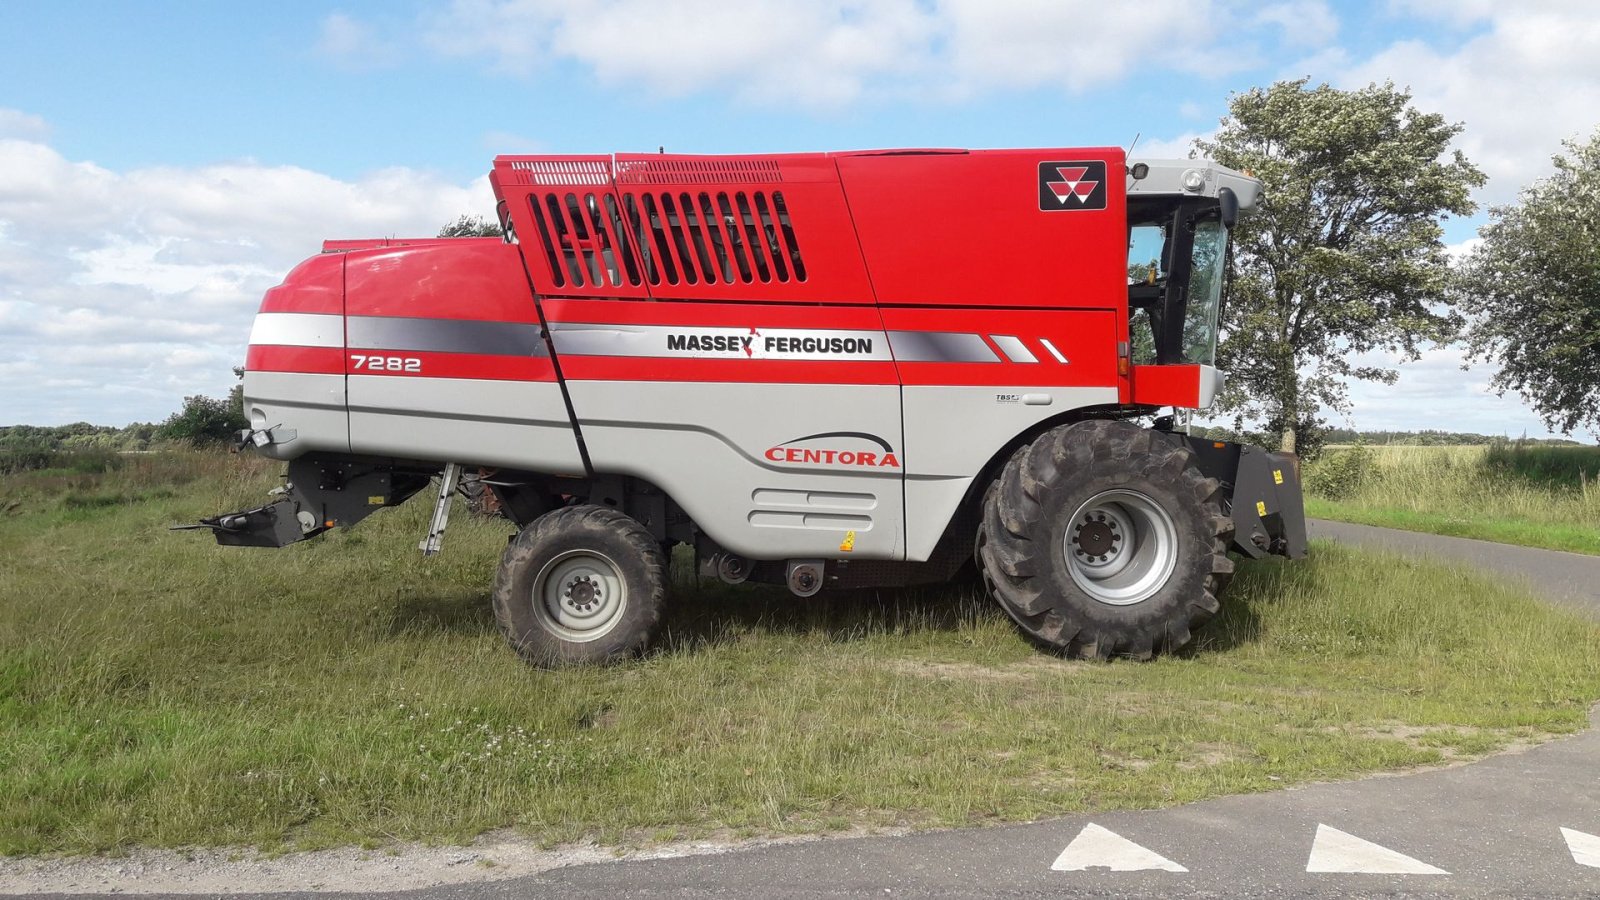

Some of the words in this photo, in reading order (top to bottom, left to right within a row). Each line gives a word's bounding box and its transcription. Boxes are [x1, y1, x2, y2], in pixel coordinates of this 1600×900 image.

[667, 335, 753, 352] MASSEY
[765, 337, 873, 354] FERGUSON
[350, 355, 421, 373] 7282
[764, 447, 901, 468] CENTORA
